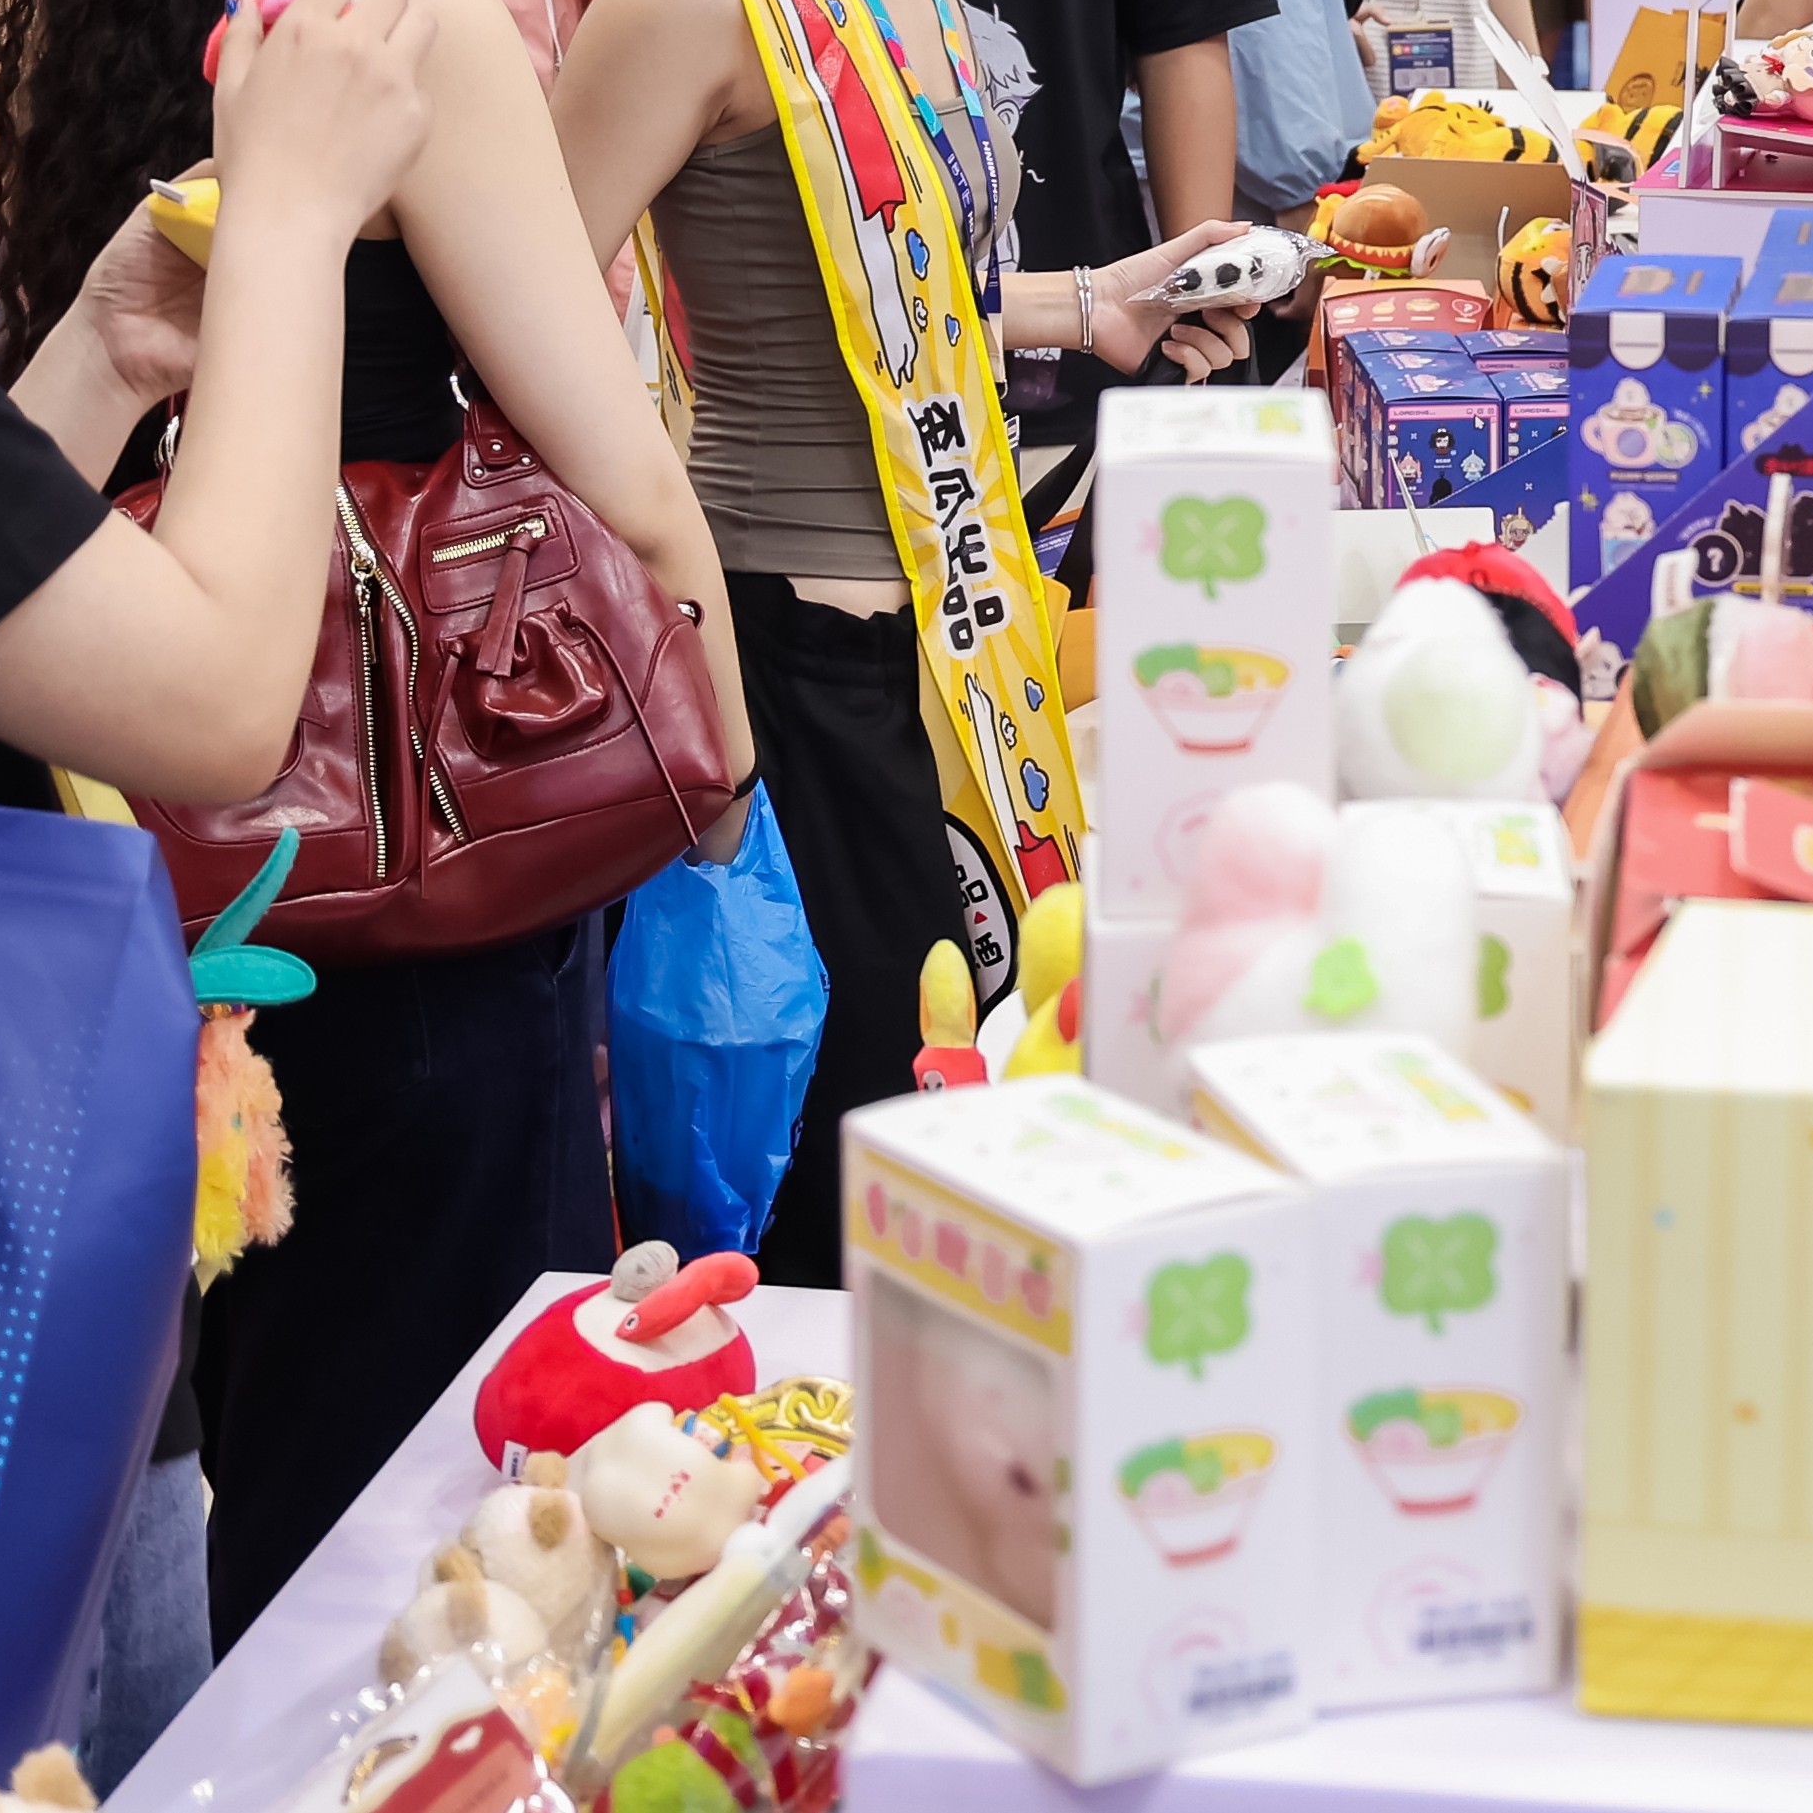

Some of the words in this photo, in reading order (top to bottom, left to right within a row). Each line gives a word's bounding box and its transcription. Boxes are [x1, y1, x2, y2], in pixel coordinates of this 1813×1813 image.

[946, 152, 975, 209] IBTE
[907, 400, 1003, 651] 歪瓜出品
